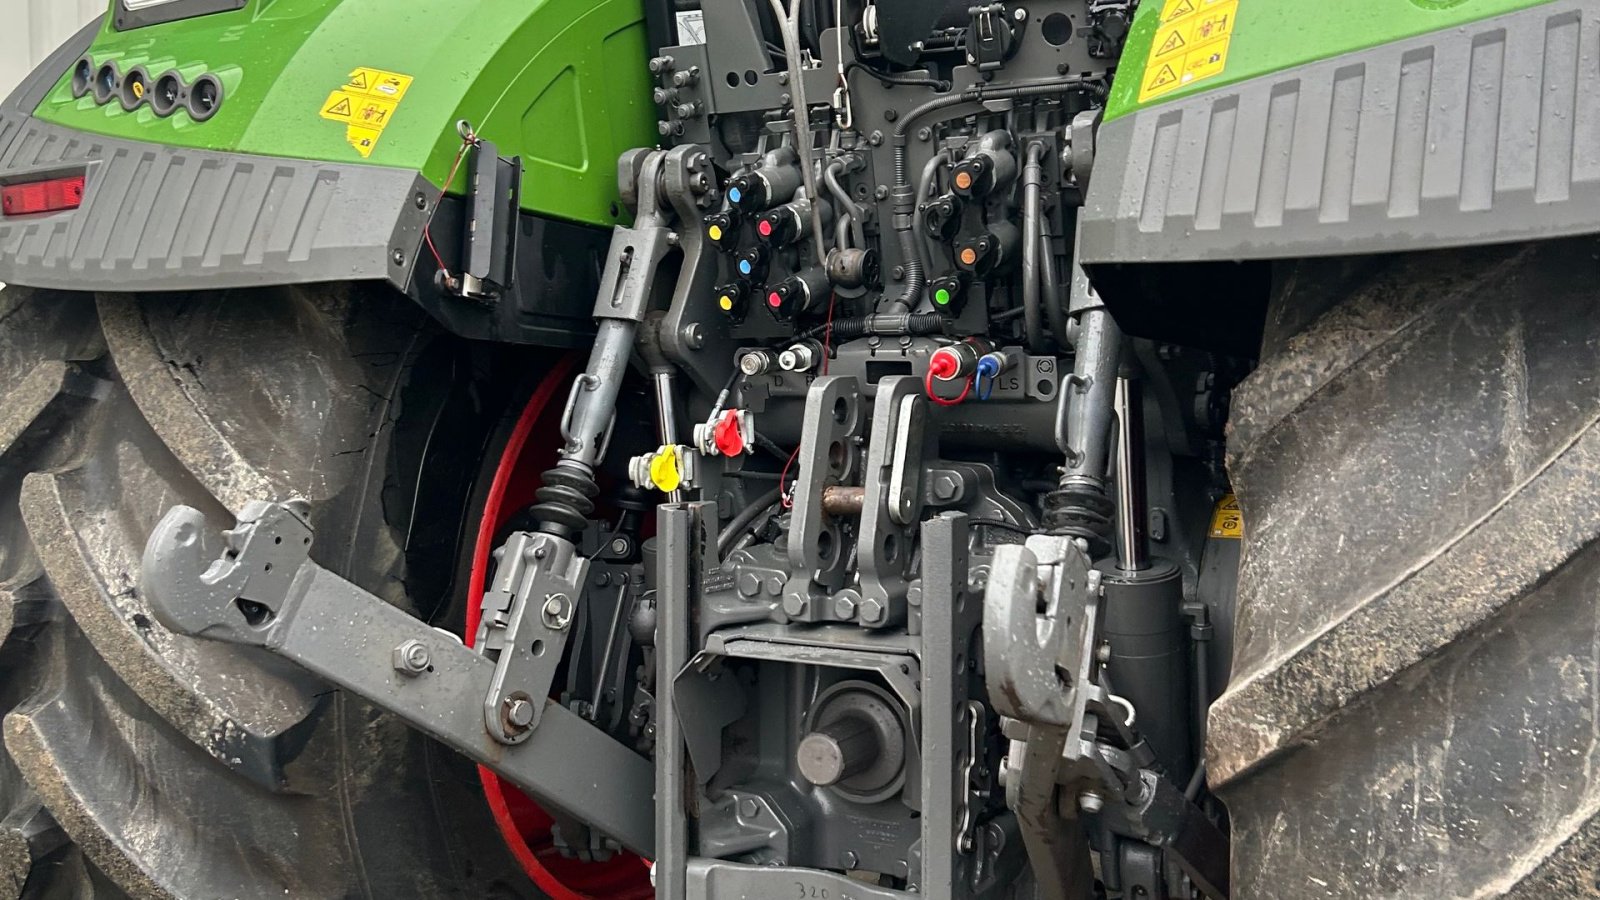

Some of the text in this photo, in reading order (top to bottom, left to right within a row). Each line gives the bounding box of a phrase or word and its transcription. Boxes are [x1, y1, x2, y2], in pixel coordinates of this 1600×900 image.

[774, 375, 784, 387] D
[999, 377, 1020, 390] LS
[794, 882, 829, 900] 320
